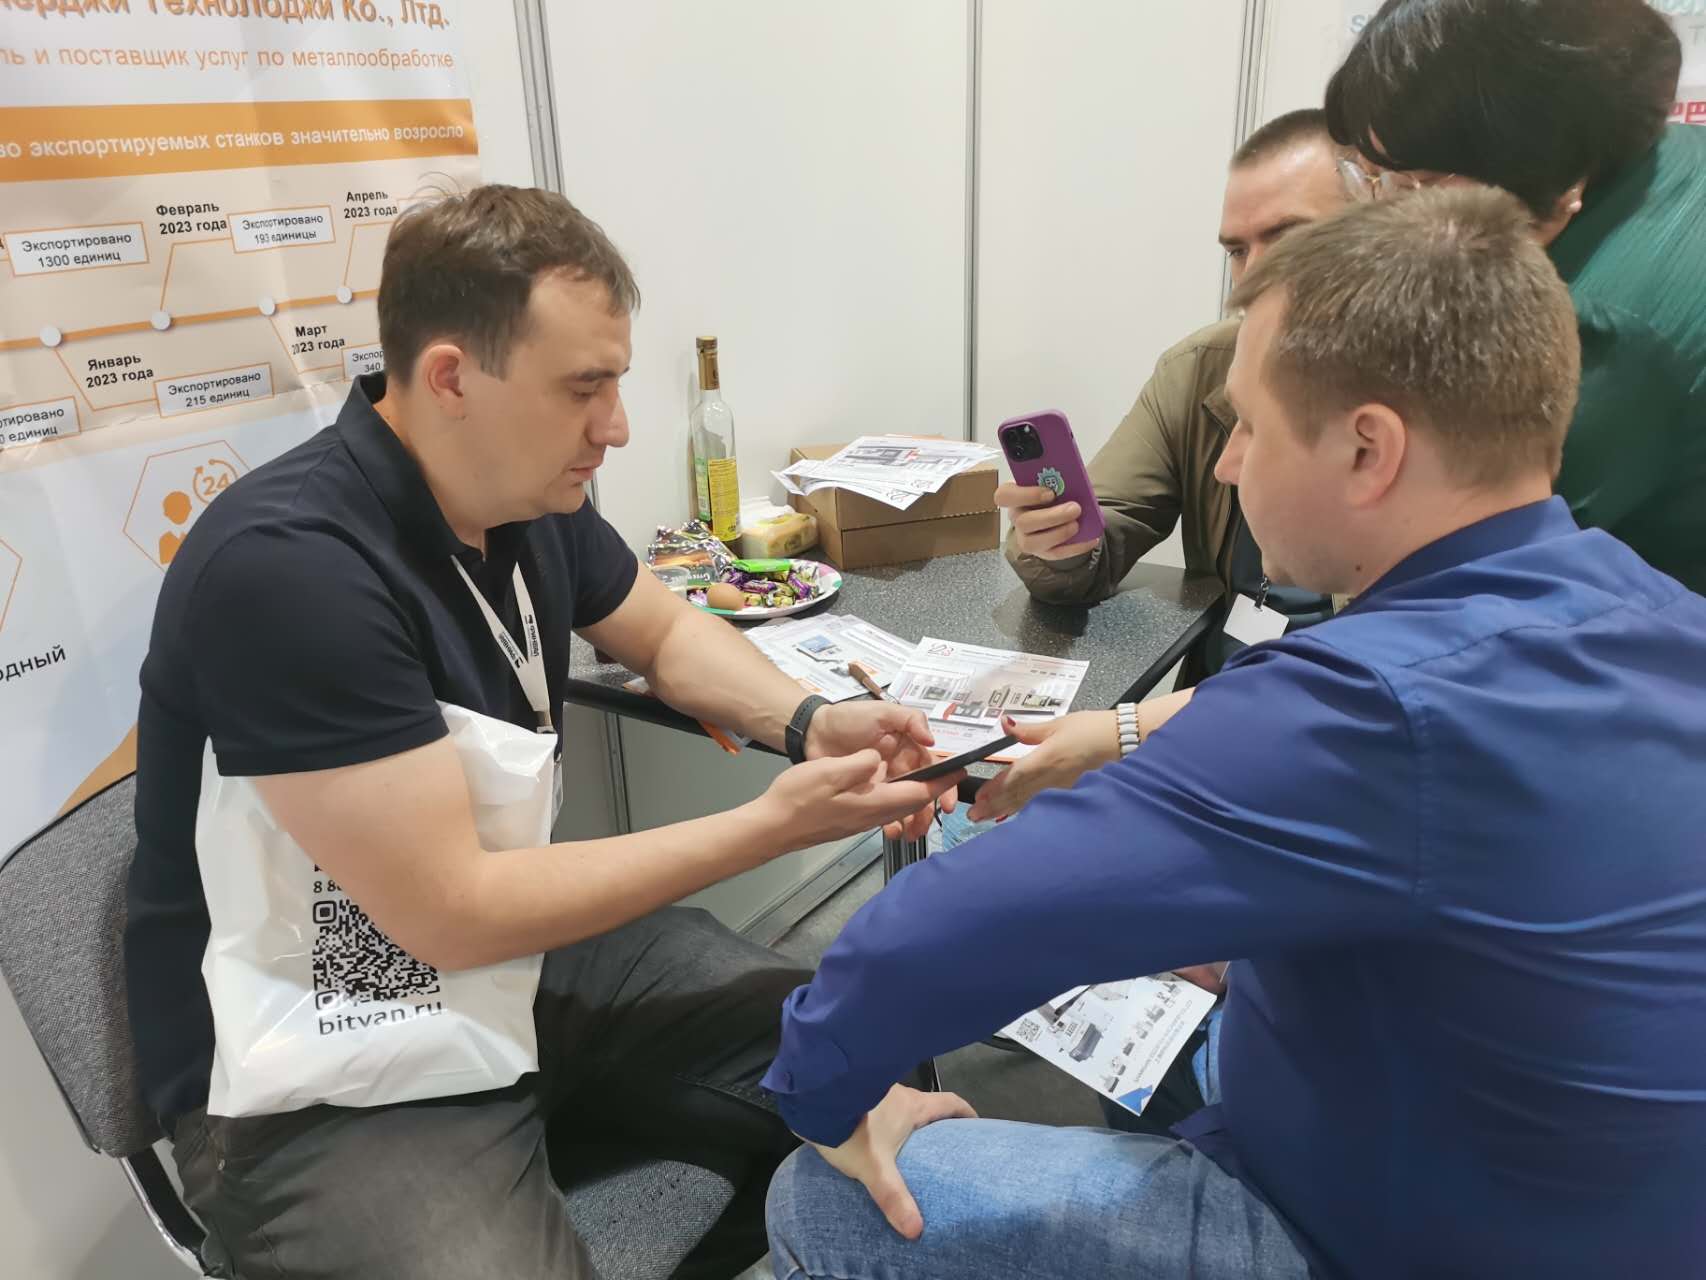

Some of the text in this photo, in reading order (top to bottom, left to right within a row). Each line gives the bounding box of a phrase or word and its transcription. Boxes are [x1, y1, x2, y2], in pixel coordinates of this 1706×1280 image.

[401, 0, 450, 30] Лтд.
[34, 48, 50, 65] и
[58, 48, 190, 69] поставщик
[195, 50, 248, 71] услуг
[257, 51, 284, 66] по
[292, 48, 454, 71] металлообработке
[30, 133, 210, 158] экспортируемых
[215, 129, 284, 148] станков
[290, 127, 390, 145] значительно
[394, 123, 464, 144] возросло
[346, 191, 389, 203] Апрель
[156, 201, 220, 218] Февраль
[343, 206, 398, 219] 2023 года
[159, 218, 228, 236] 2023 года
[241, 214, 324, 230] Экспортировано
[21, 232, 132, 253] Экспортировано
[271, 230, 317, 242] единицы
[38, 251, 121, 269] 1300 единиц
[295, 325, 328, 338] Март
[318, 338, 345, 350] года
[87, 353, 142, 372] Январь
[364, 362, 381, 373] 340
[86, 367, 154, 389] 2023 года
[168, 371, 261, 396] Экспортировано
[186, 388, 251, 408] 215 единиц
[8, 427, 58, 442] единиц
[313, 880, 322, 893] 8
